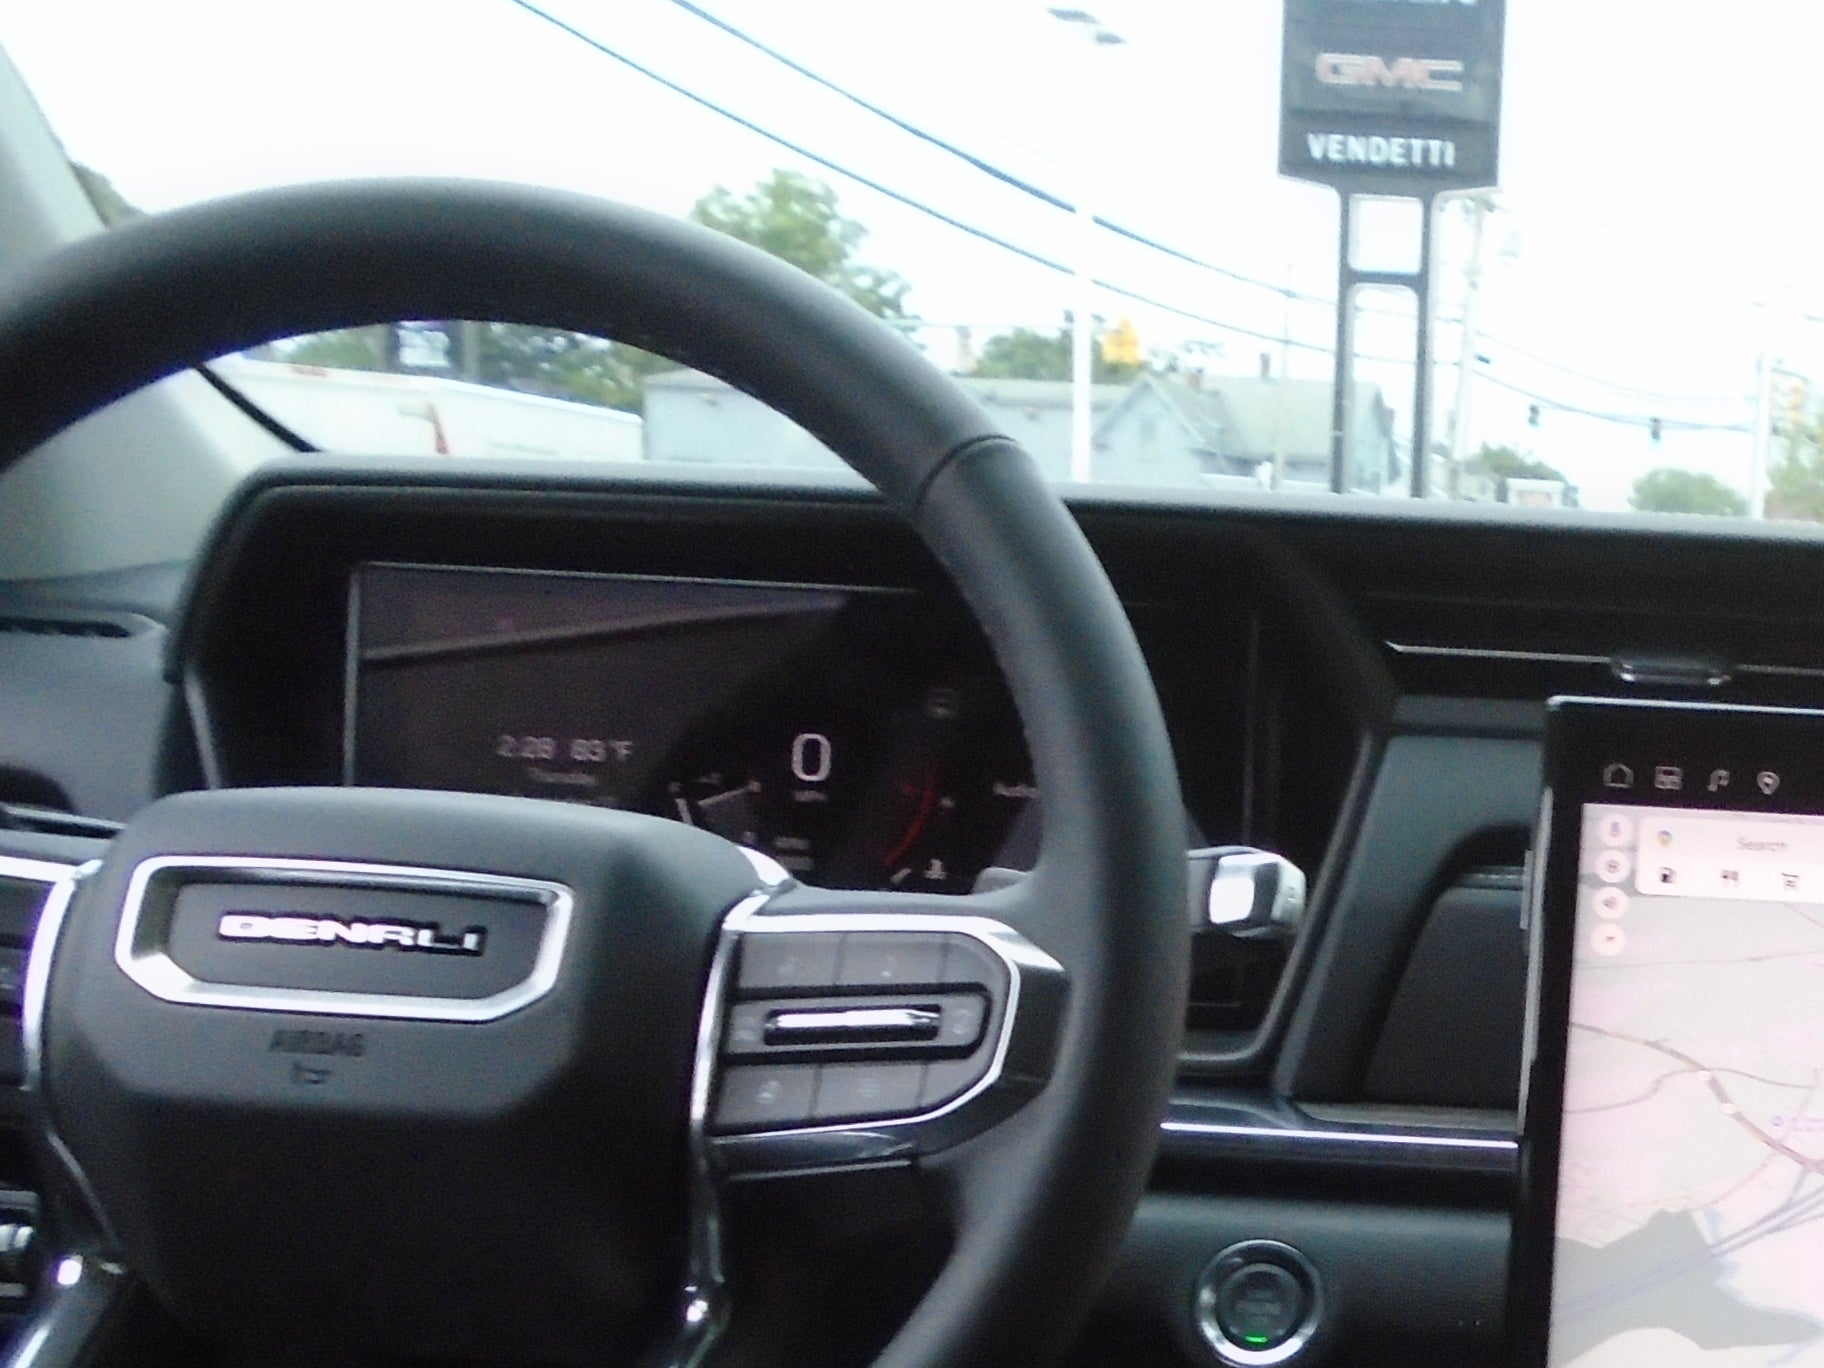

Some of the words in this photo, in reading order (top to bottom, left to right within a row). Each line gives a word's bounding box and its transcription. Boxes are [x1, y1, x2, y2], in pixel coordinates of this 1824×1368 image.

[1315, 53, 1464, 92] GMC
[1306, 133, 1456, 167] VENDETTI
[791, 732, 832, 782] 0
[1735, 836, 1787, 853] Search
[218, 913, 487, 955] DENALI
